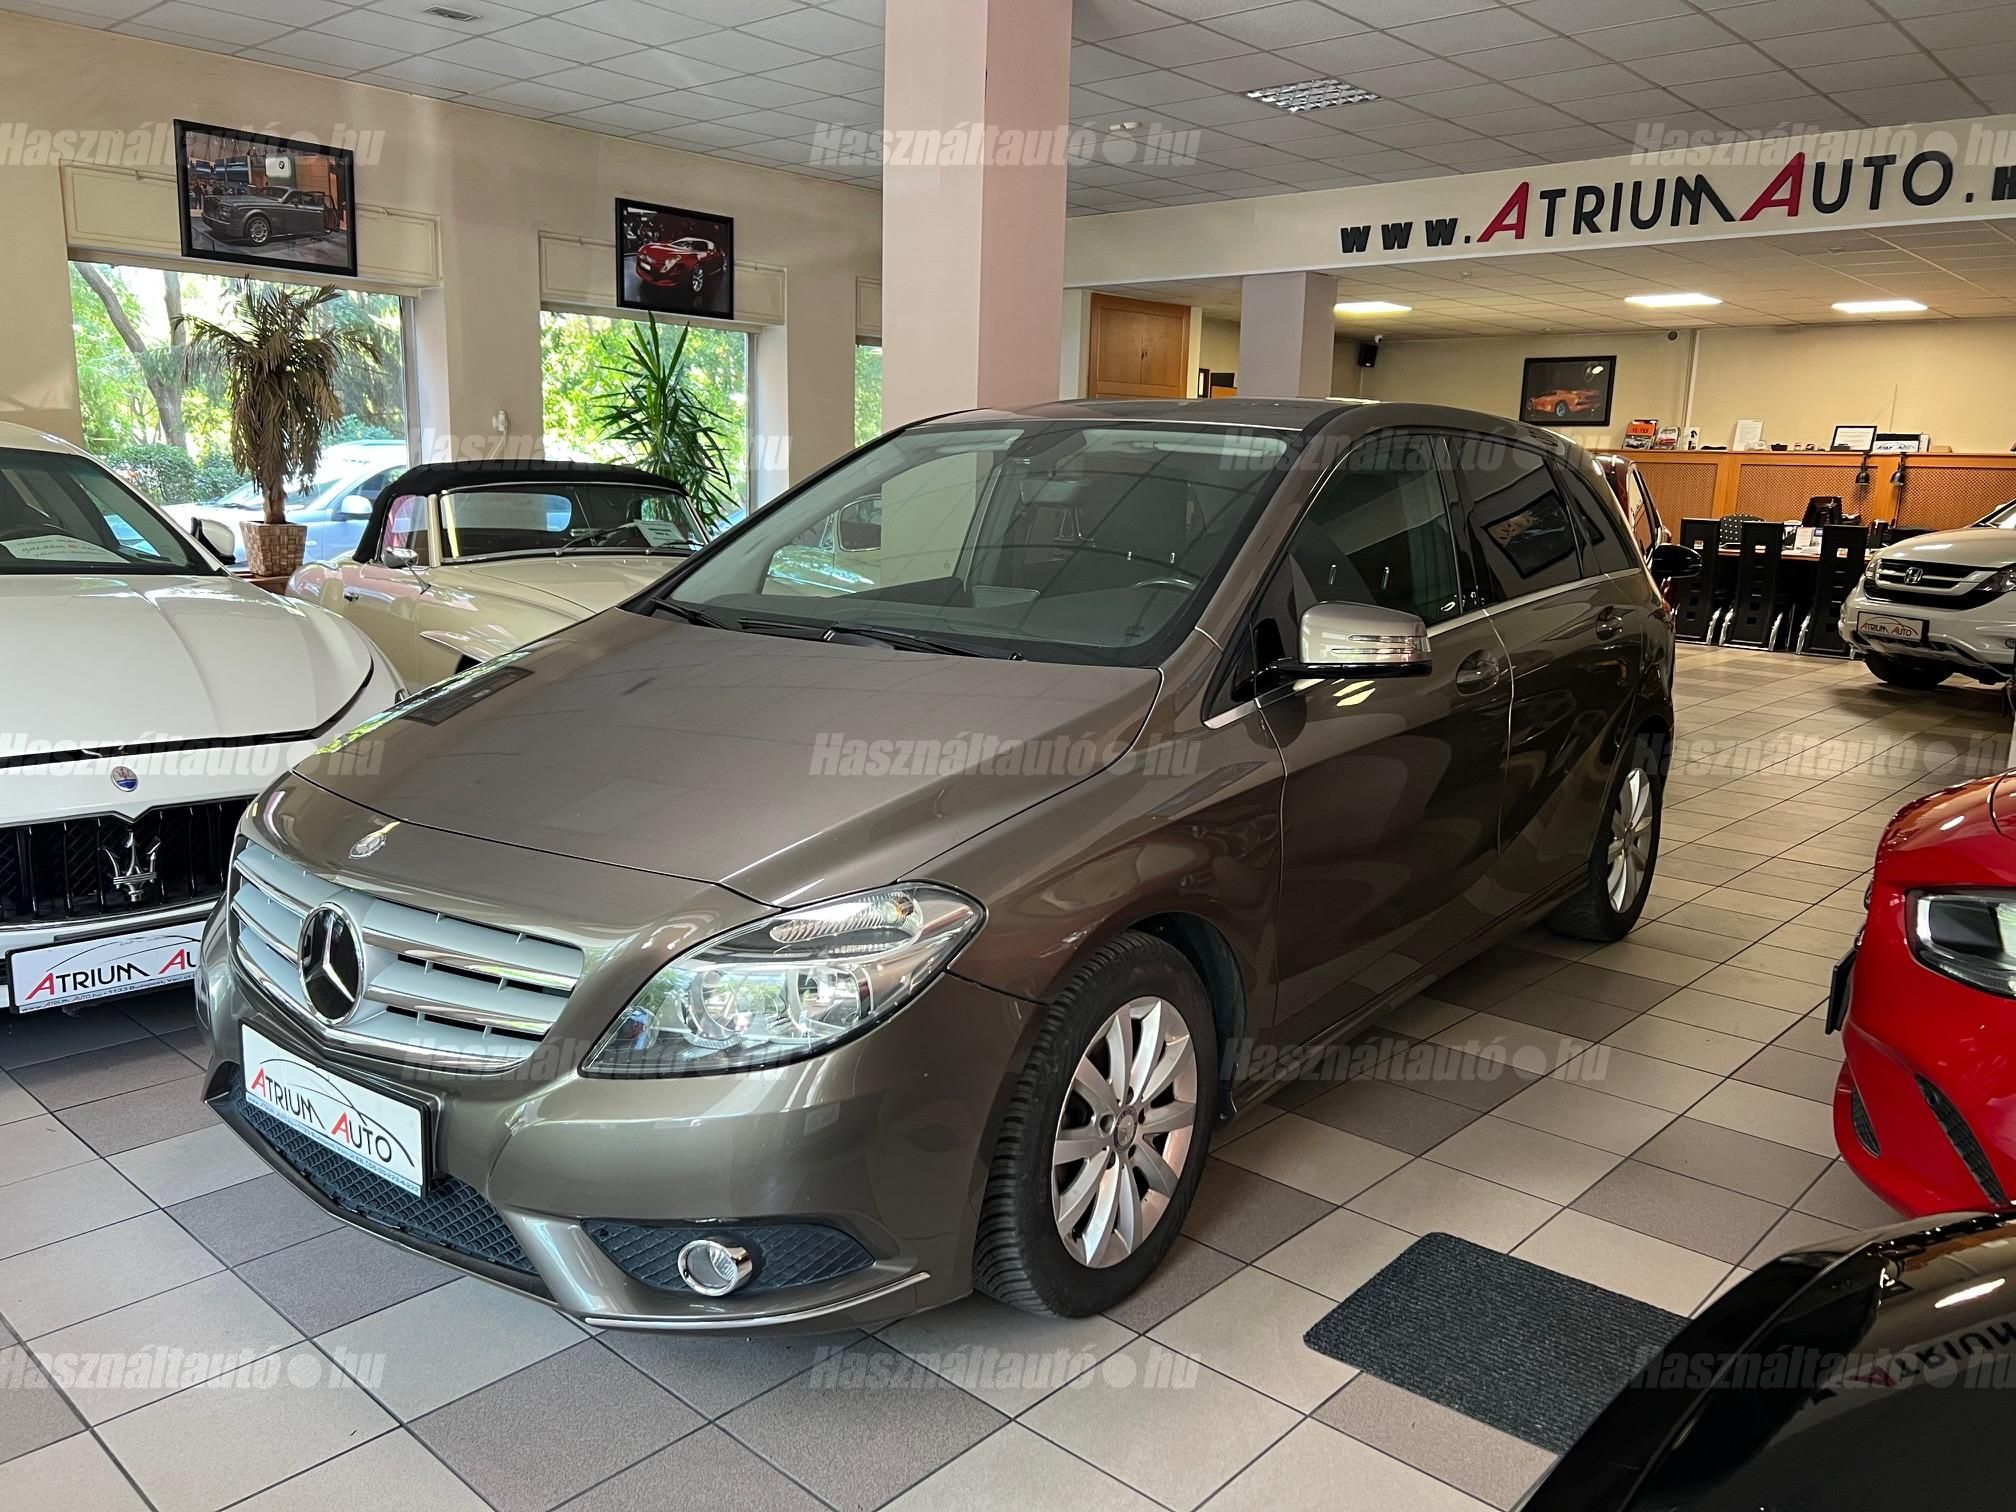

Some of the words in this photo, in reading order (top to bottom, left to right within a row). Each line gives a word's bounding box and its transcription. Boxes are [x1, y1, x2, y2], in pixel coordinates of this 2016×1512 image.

[1891, 627, 1912, 637] AUTO
[25, 962, 151, 1001] ATRIUM
[158, 948, 197, 975] AU
[250, 1066, 327, 1131] ATRIUM
[330, 1111, 393, 1164] AUTO
